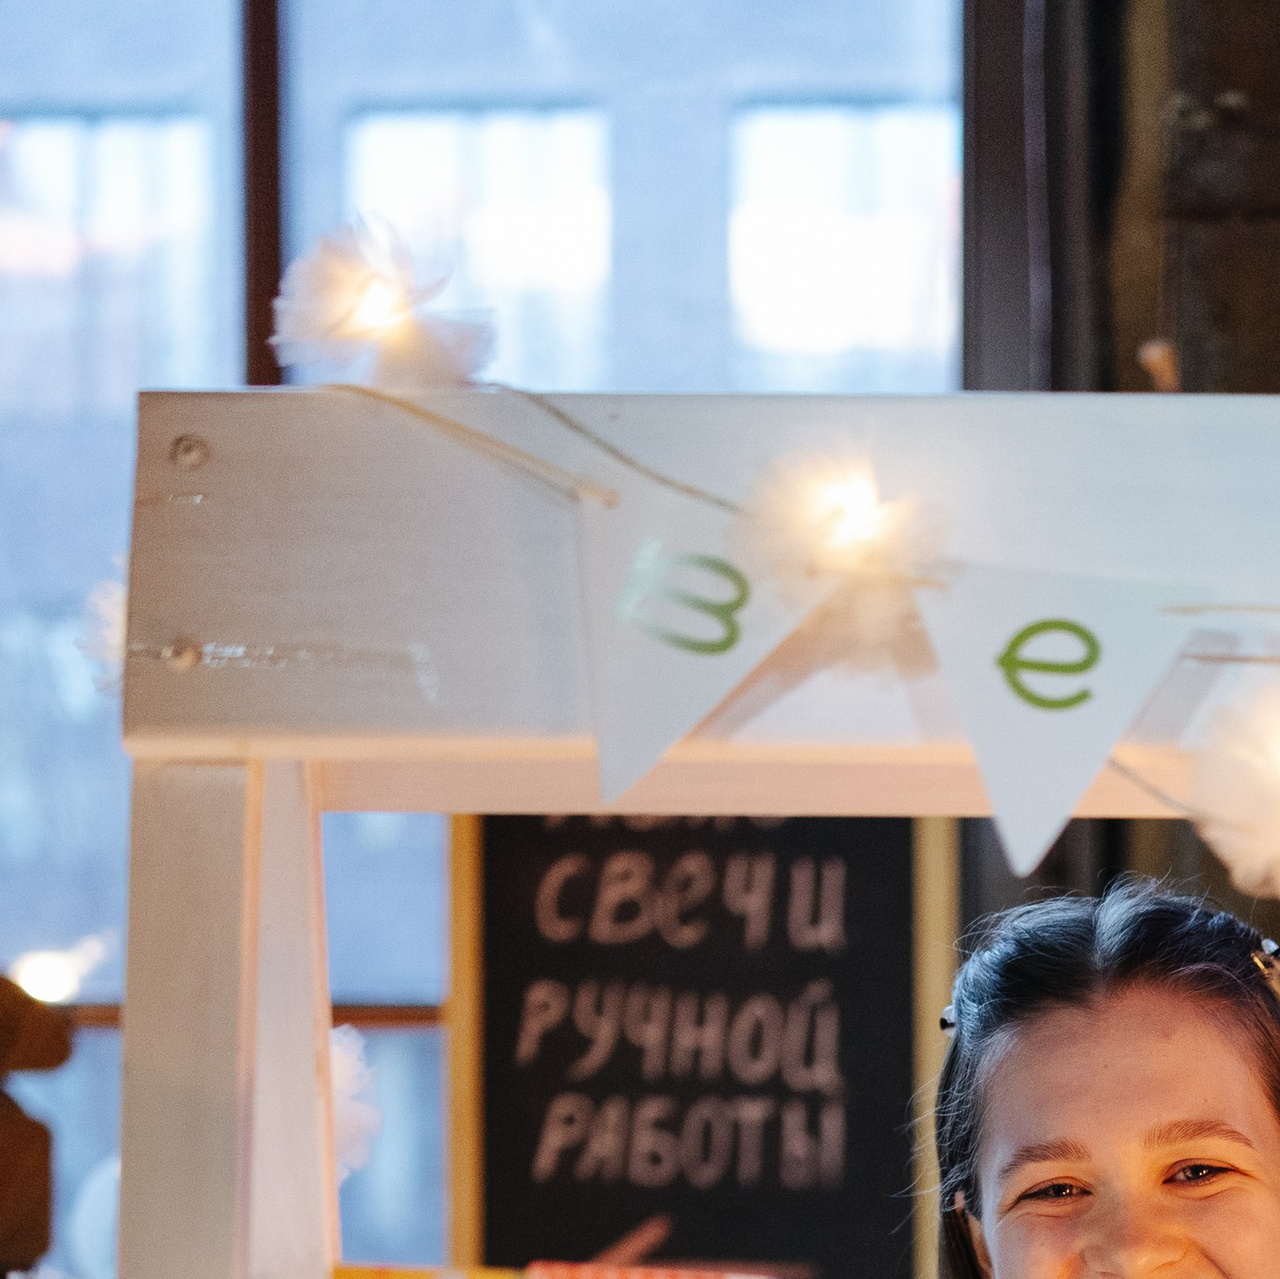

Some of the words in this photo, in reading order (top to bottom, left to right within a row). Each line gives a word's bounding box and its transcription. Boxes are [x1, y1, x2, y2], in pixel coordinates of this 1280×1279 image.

[533, 850, 848, 952] СВЕЧИ
[514, 979, 845, 1097] РУЧНОЙ
[531, 1093, 848, 1190] РАБОТЫ
